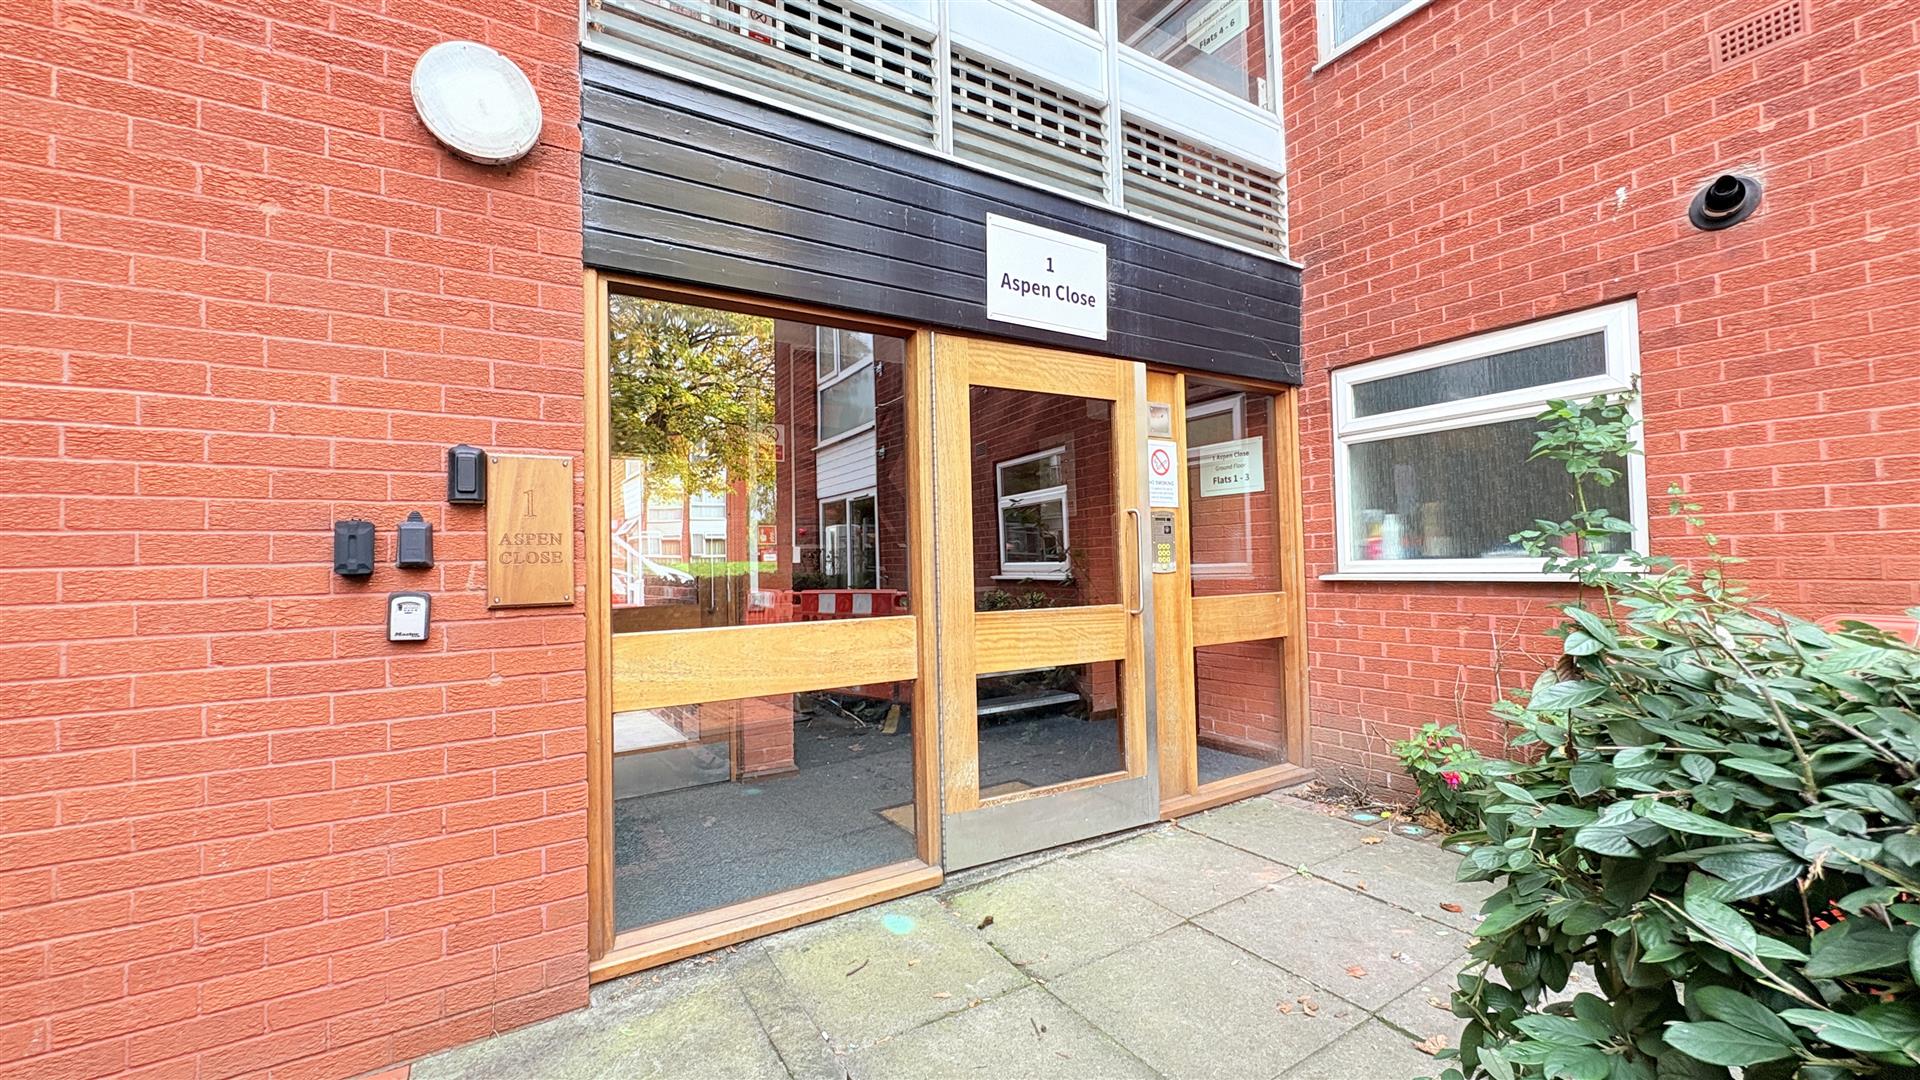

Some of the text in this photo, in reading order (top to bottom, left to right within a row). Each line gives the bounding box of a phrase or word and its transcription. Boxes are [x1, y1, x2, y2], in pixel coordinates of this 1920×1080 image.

[1199, 32, 1218, 49] Flats
[1230, 18, 1235, 27] 6
[1046, 257, 1054, 273] 1
[1000, 272, 1096, 308] Aspen Close
[1212, 476, 1232, 485] Flats
[1233, 474, 1238, 482] 1
[1244, 473, 1250, 481] 3
[523, 489, 537, 517] 1
[498, 532, 562, 546] ASPEN
[499, 551, 563, 565] CLOSE
